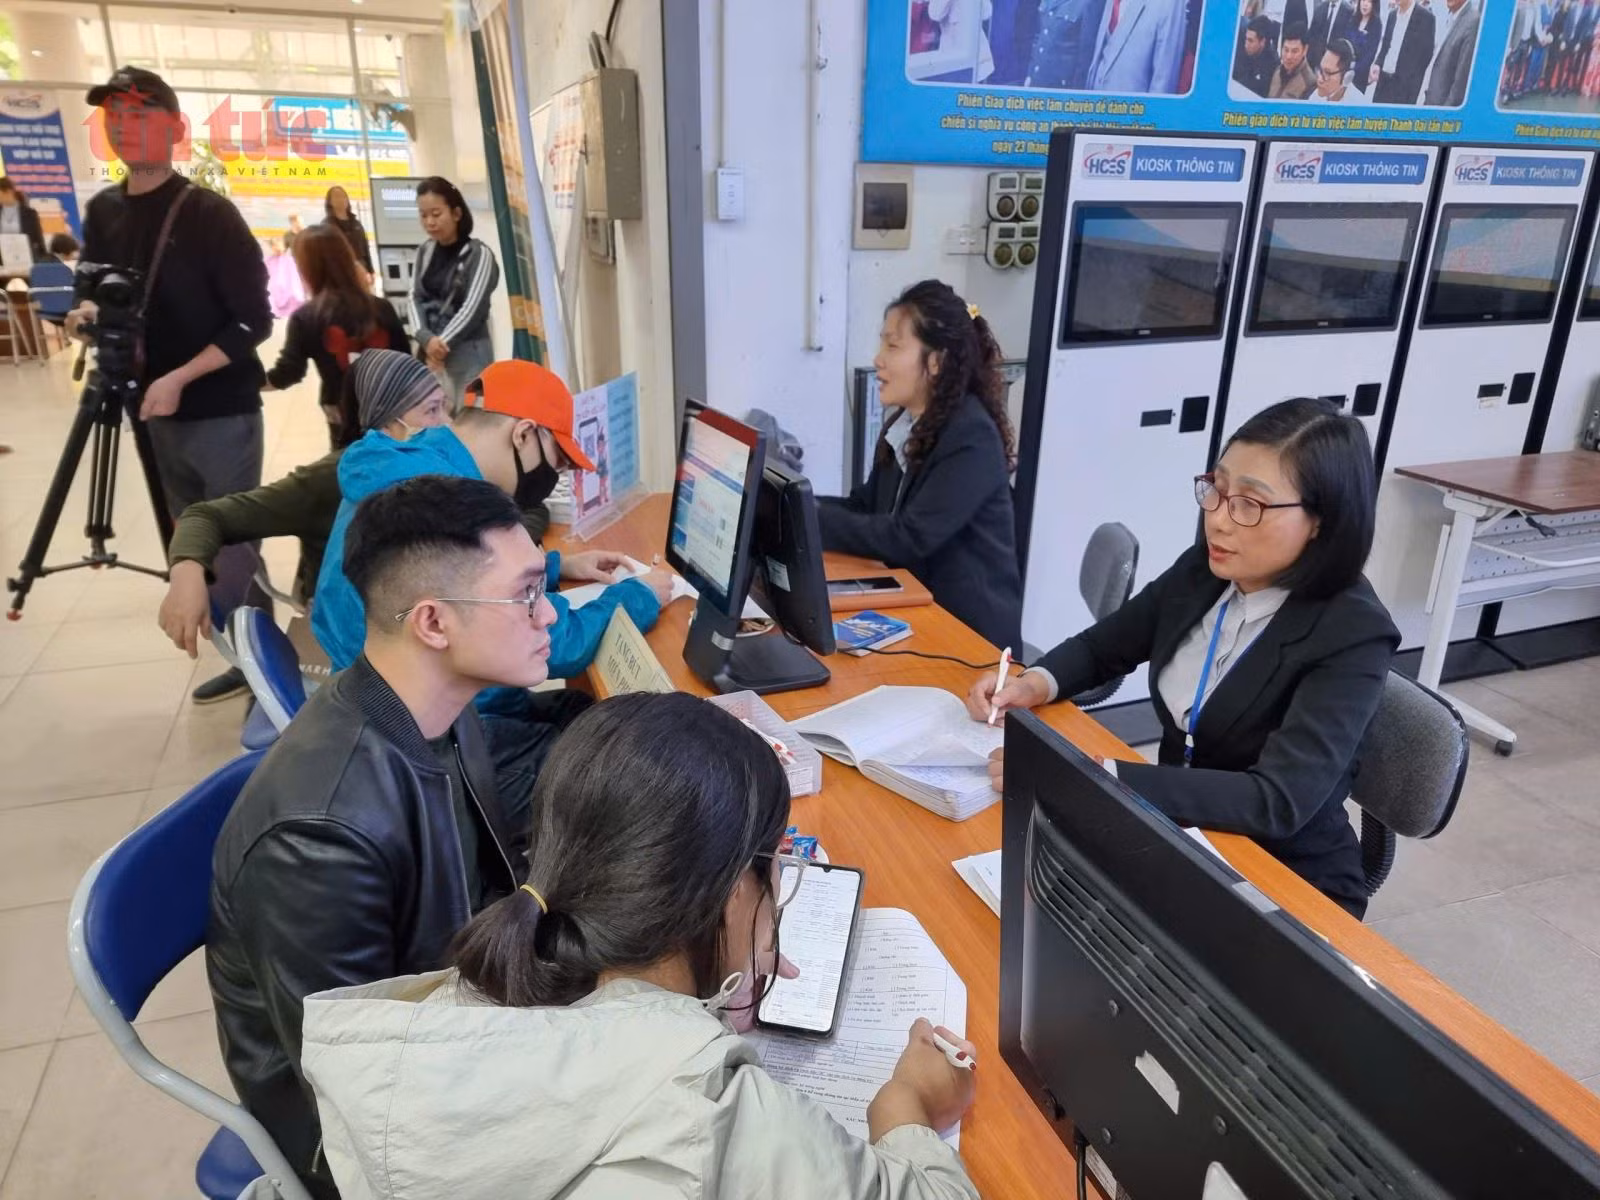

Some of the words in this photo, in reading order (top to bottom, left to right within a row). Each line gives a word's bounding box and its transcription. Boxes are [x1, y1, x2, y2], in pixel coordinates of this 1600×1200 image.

[1089, 158, 1127, 175] HCES
[1136, 157, 1173, 172] KIOSK
[1176, 156, 1215, 173] THÔNG
[1217, 160, 1235, 174] TIN
[1280, 164, 1316, 179] HCES
[1325, 162, 1360, 176] KIOSK
[1362, 160, 1400, 176] THÔNG
[1402, 164, 1419, 176] TIN
[1458, 167, 1489, 181] HCES
[1496, 166, 1526, 178] KIOSK
[1528, 165, 1560, 179] THÔNG
[1563, 168, 1577, 179] TIN
